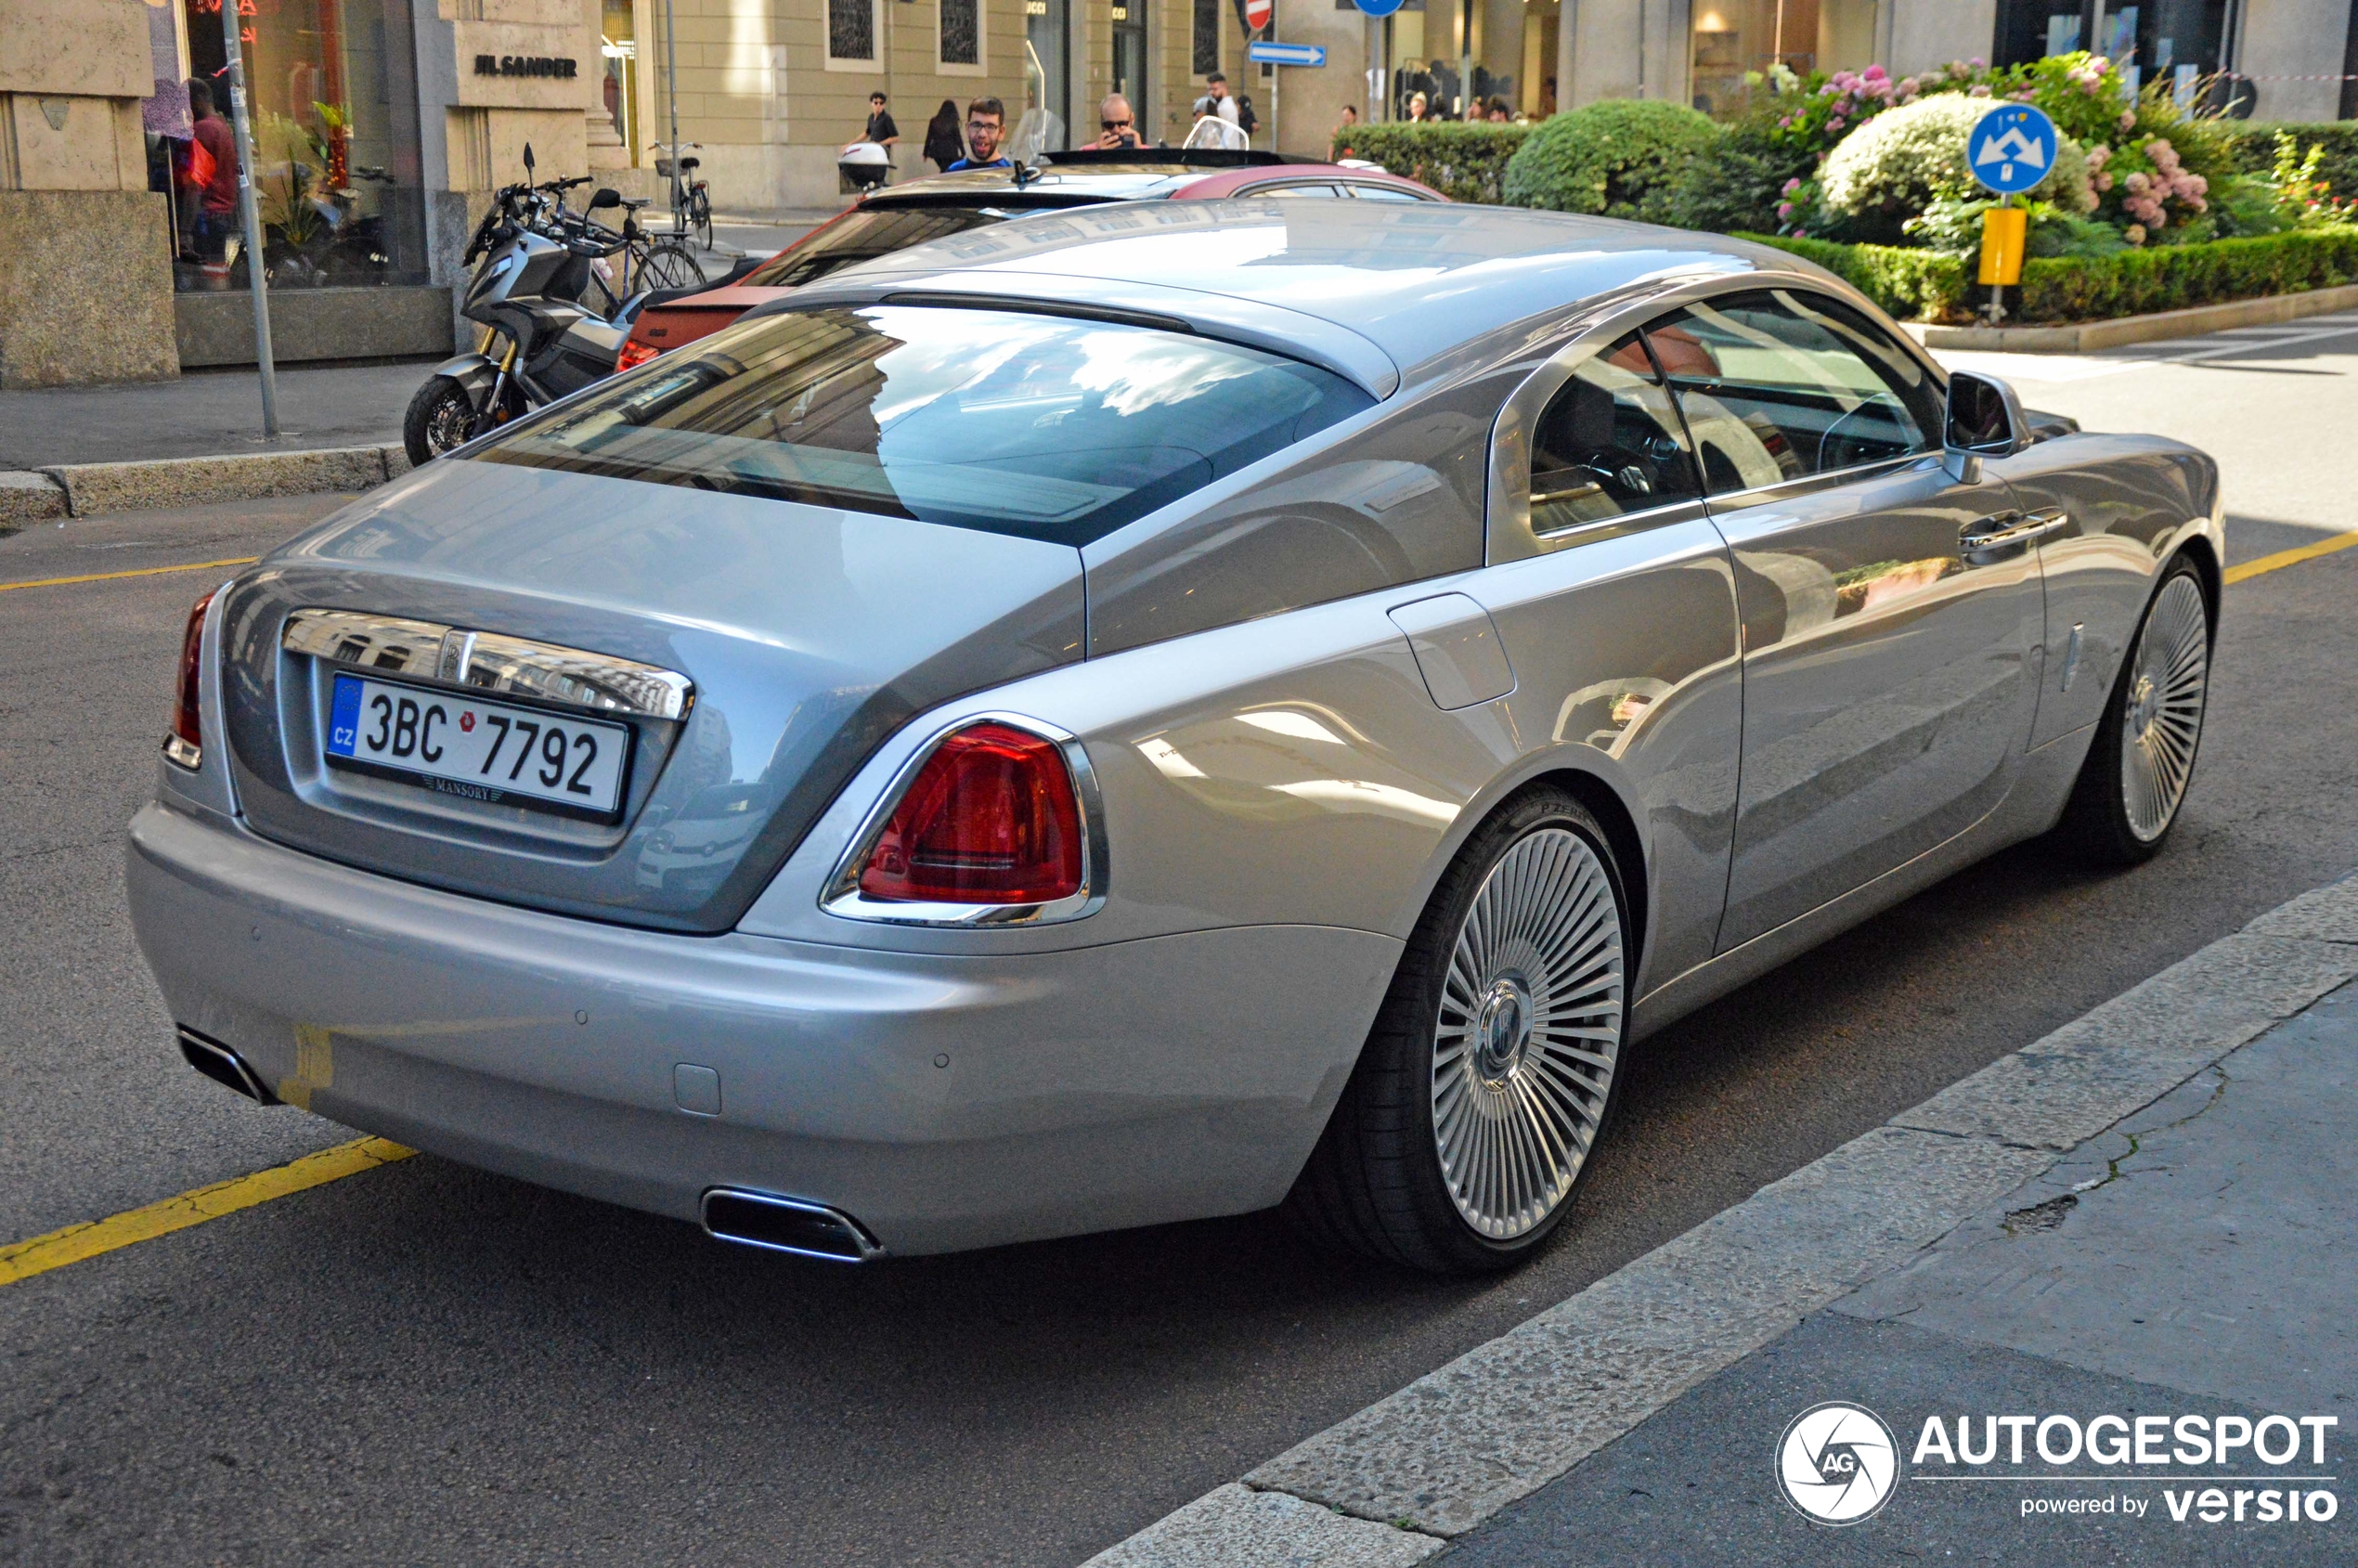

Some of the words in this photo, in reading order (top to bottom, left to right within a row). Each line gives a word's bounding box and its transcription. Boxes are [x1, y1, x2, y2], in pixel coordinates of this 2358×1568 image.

[474, 55, 500, 74] JIL
[501, 56, 577, 77] SANDER
[334, 726, 353, 746] CZ
[366, 694, 447, 763] 3BC
[480, 714, 598, 796] 7792
[436, 778, 489, 800] MANSORY
